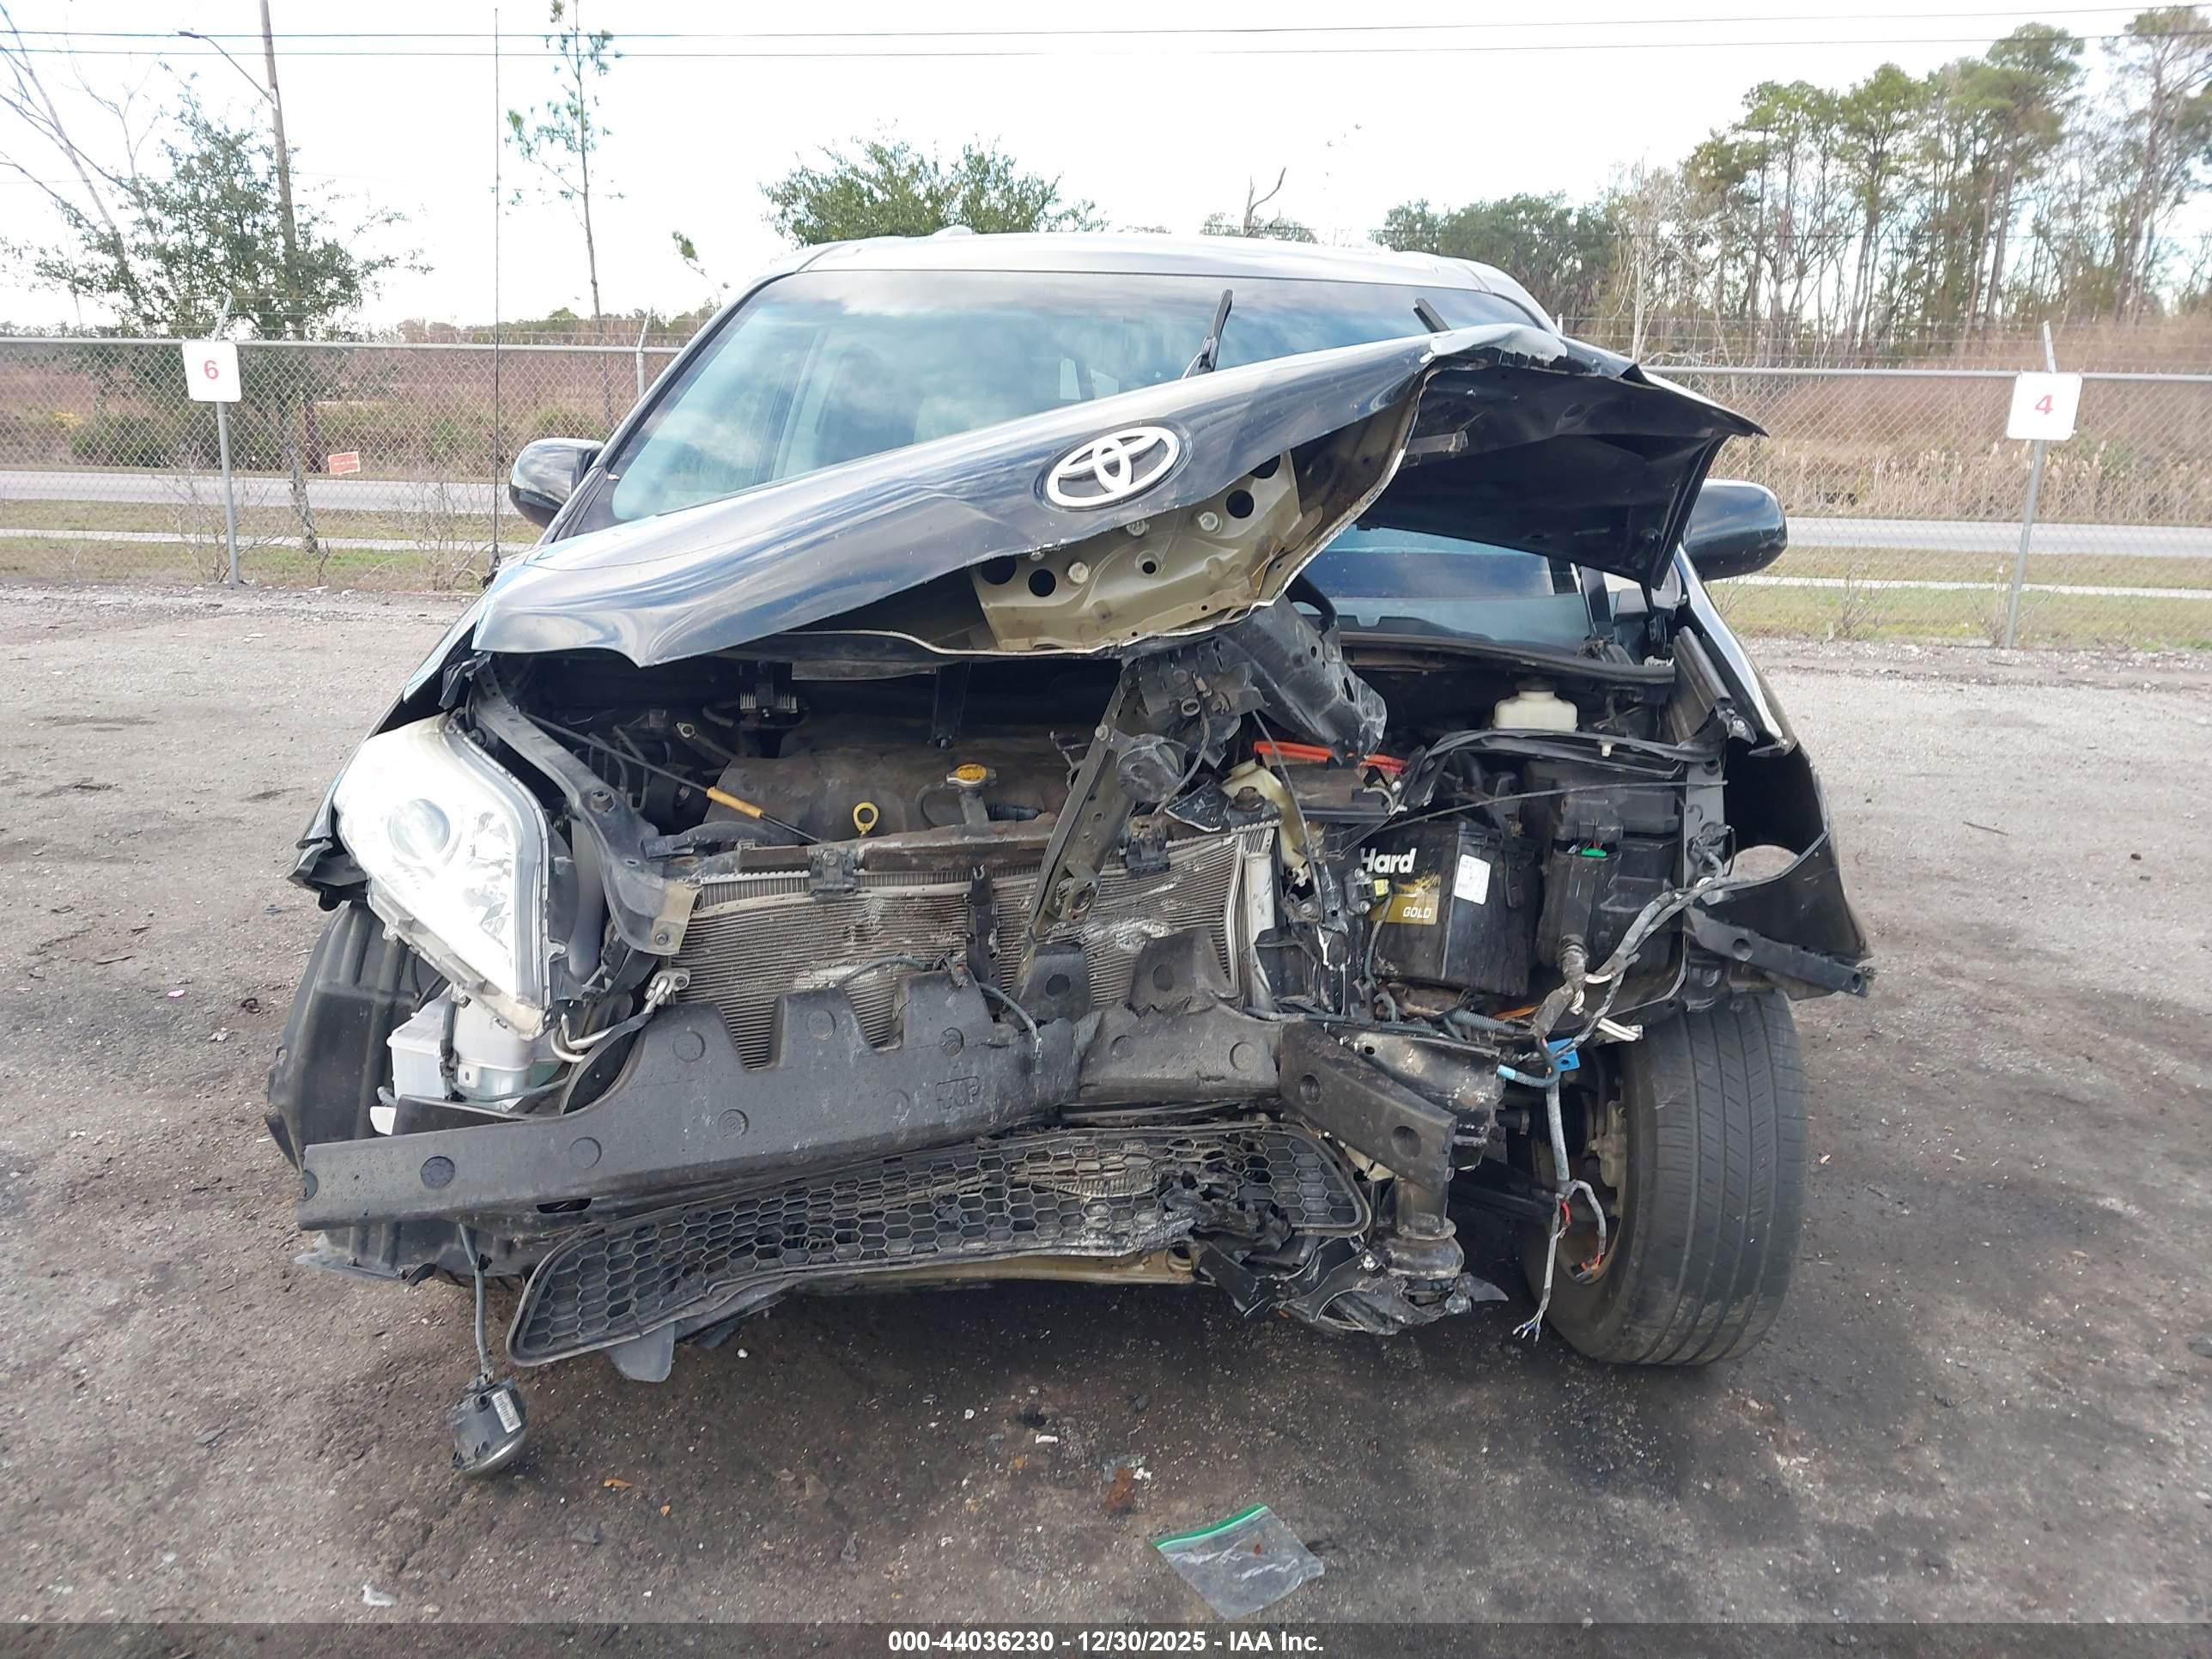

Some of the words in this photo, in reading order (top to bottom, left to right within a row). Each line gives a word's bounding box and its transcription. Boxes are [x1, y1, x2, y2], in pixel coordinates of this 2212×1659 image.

[204, 360, 219, 380] 6
[2035, 394, 2054, 415] 4
[1403, 907, 1431, 919] GOLD
